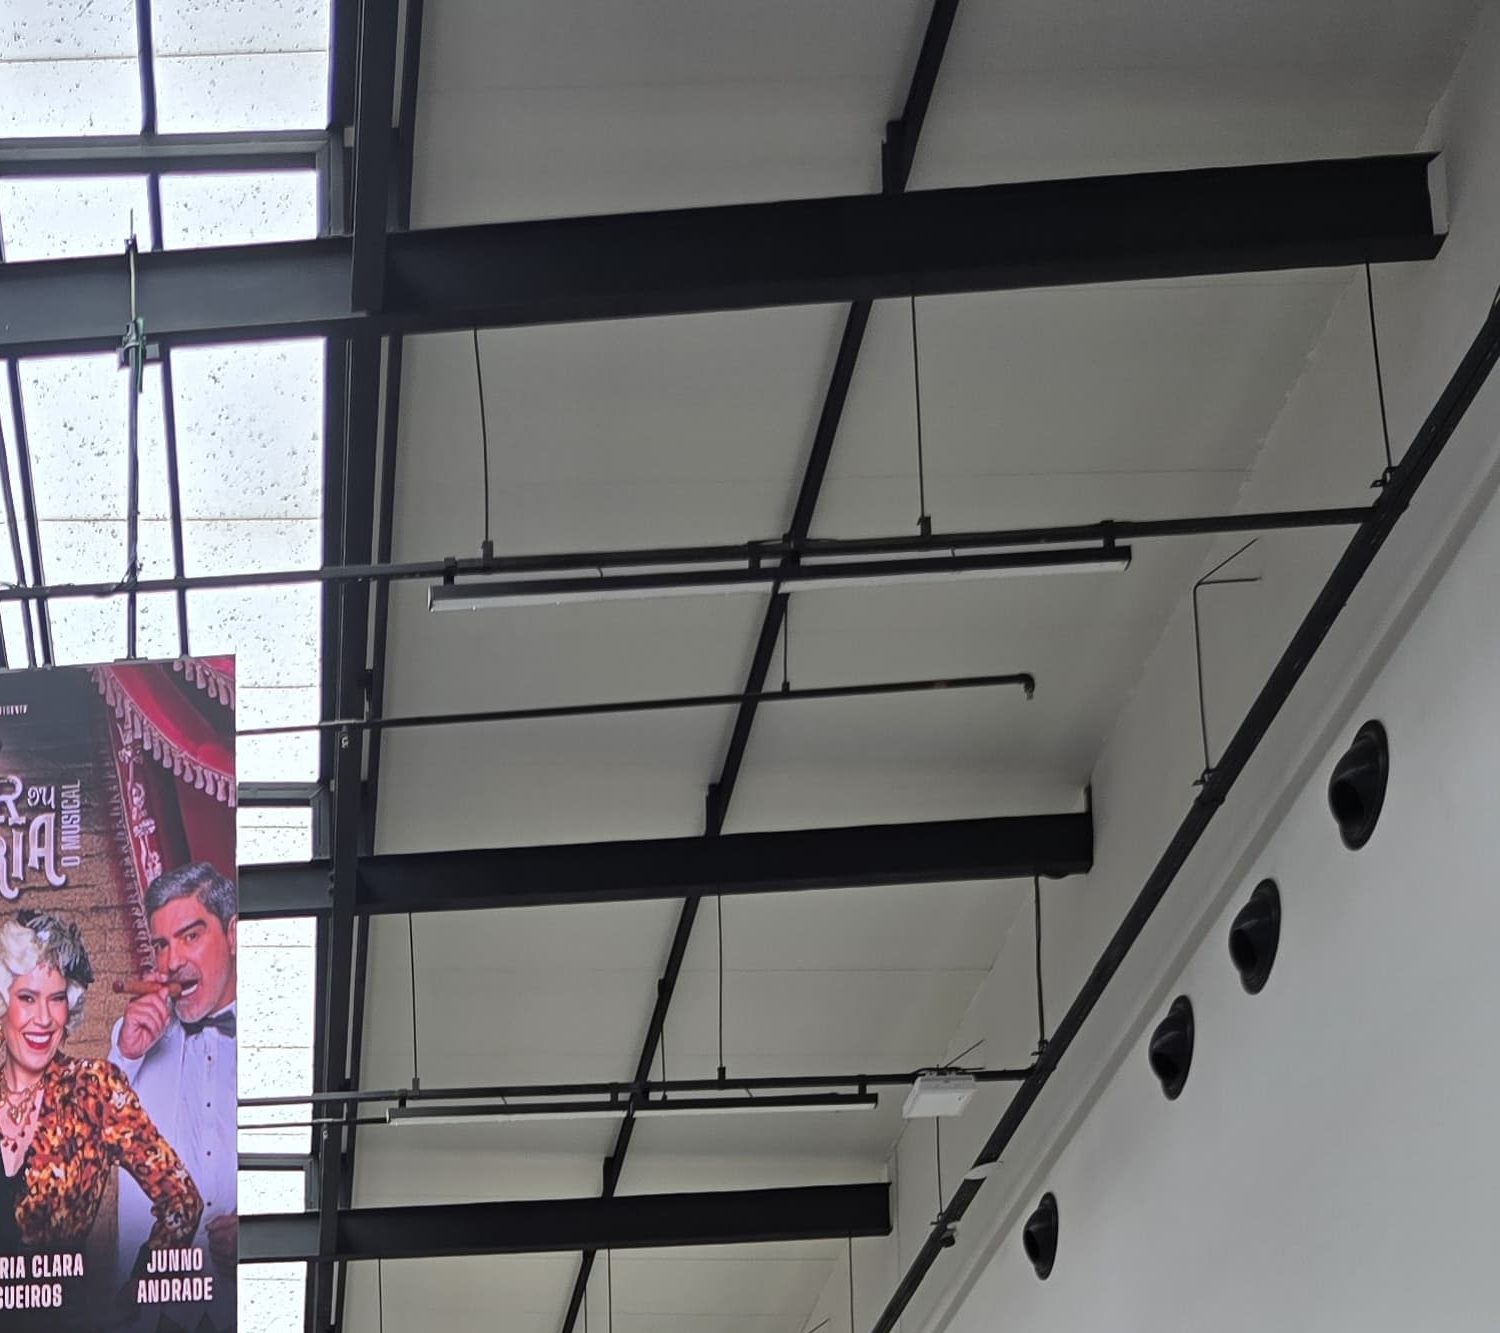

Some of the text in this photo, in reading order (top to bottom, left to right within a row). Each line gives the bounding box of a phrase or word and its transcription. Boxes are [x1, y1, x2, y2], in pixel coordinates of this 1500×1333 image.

[61, 780, 81, 852] MUSICAL
[31, 1253, 84, 1279] CLARA
[146, 1248, 203, 1274] JUNNO
[137, 1276, 213, 1303] ANDRADE
